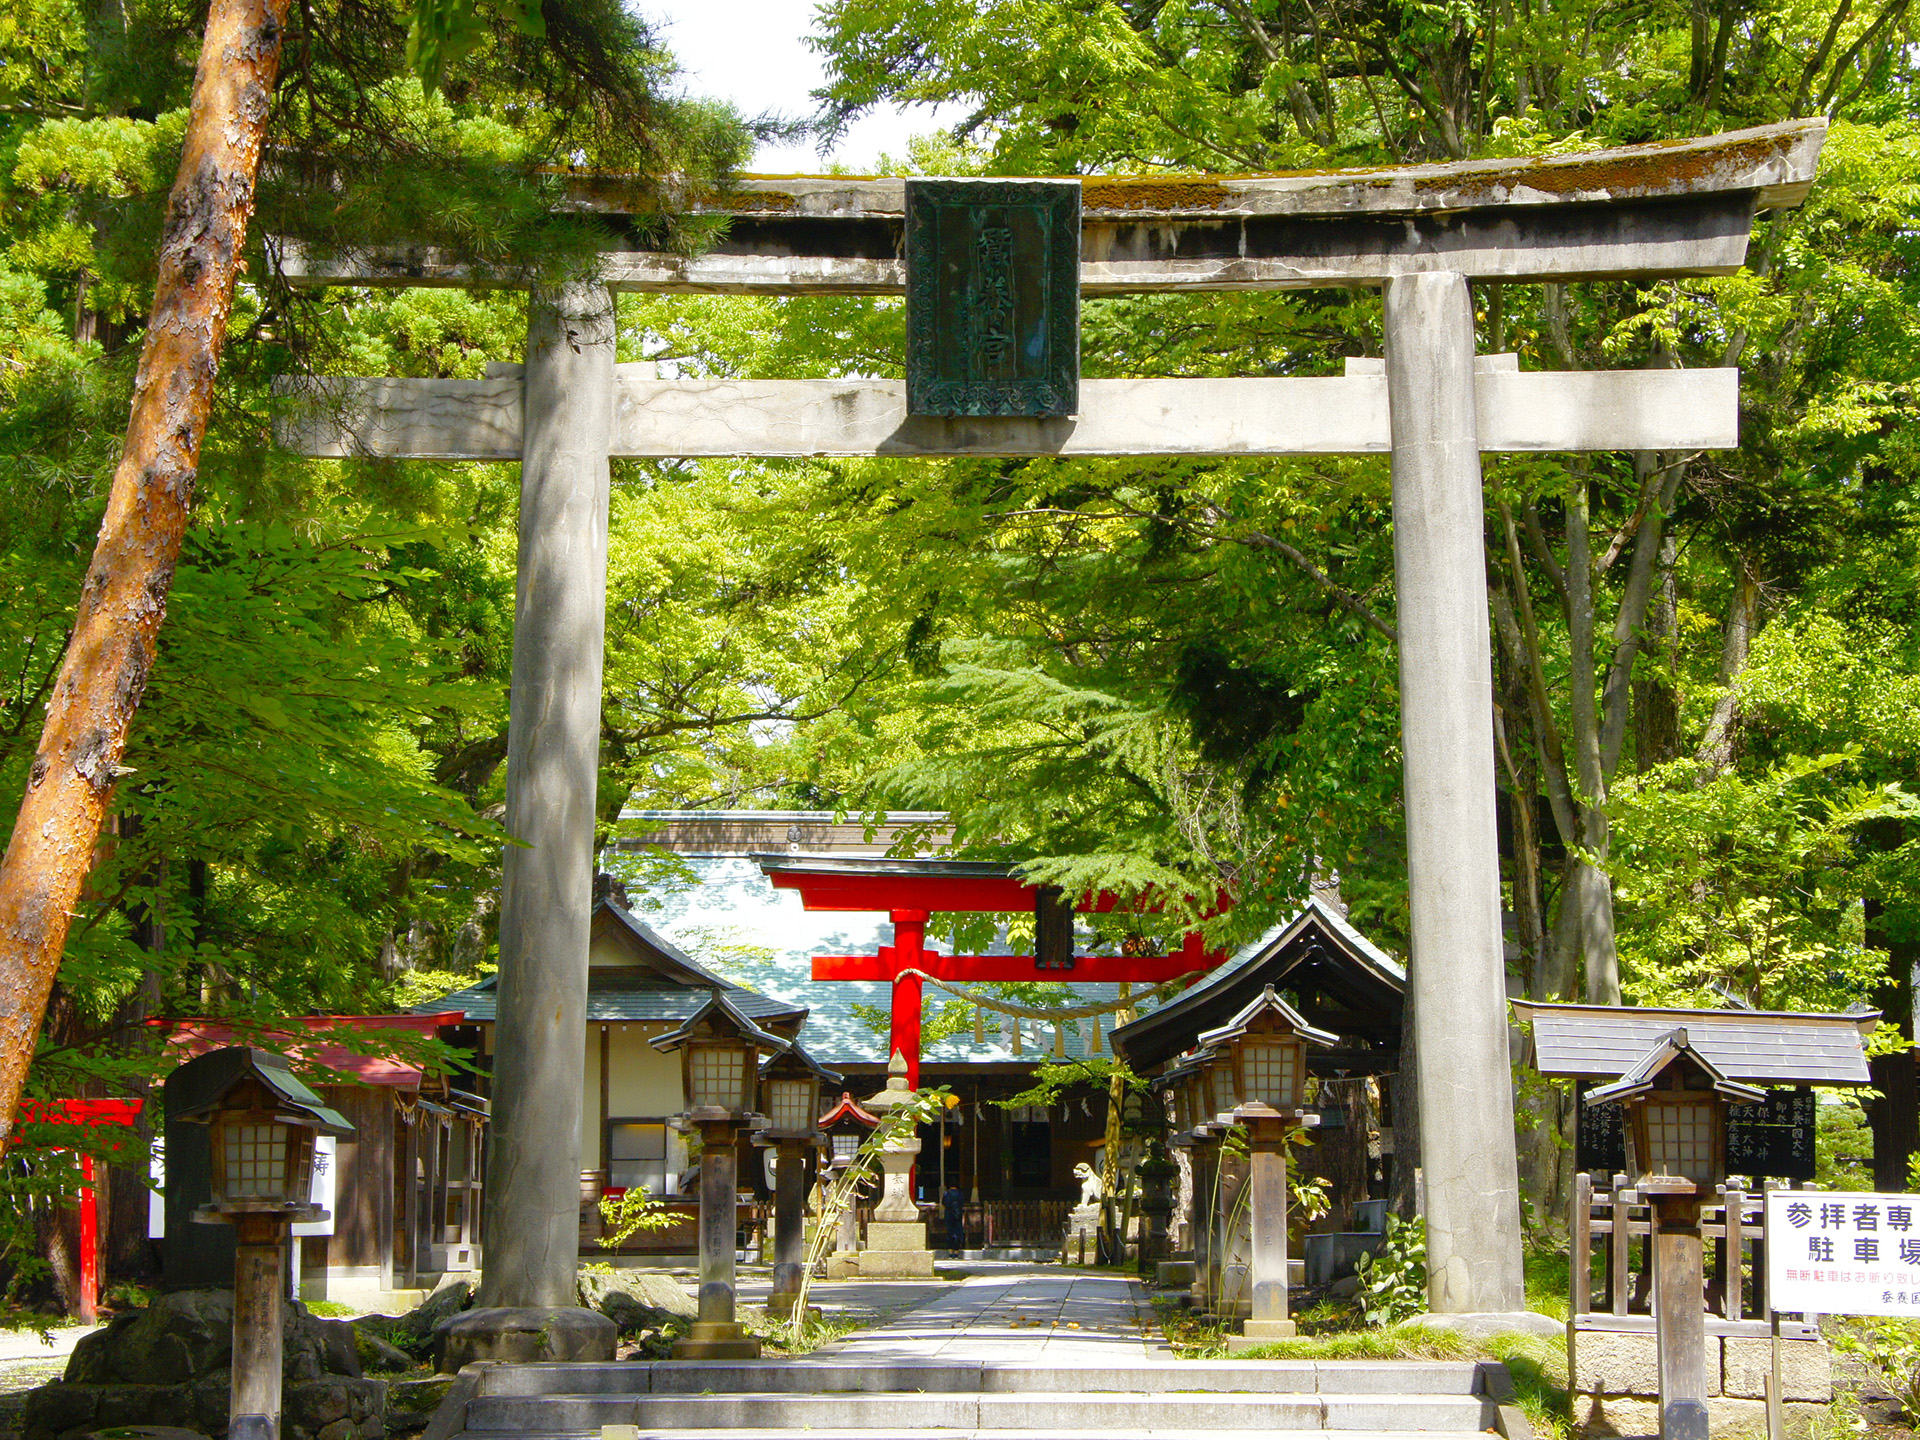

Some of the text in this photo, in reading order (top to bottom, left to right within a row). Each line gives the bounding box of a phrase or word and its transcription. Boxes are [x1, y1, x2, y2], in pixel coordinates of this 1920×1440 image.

[1786, 1202, 1913, 1232] 参拝者専
[1808, 1236, 1920, 1265] 駐車場
[1786, 1269, 1920, 1285] 無断駐車はお断り致し
